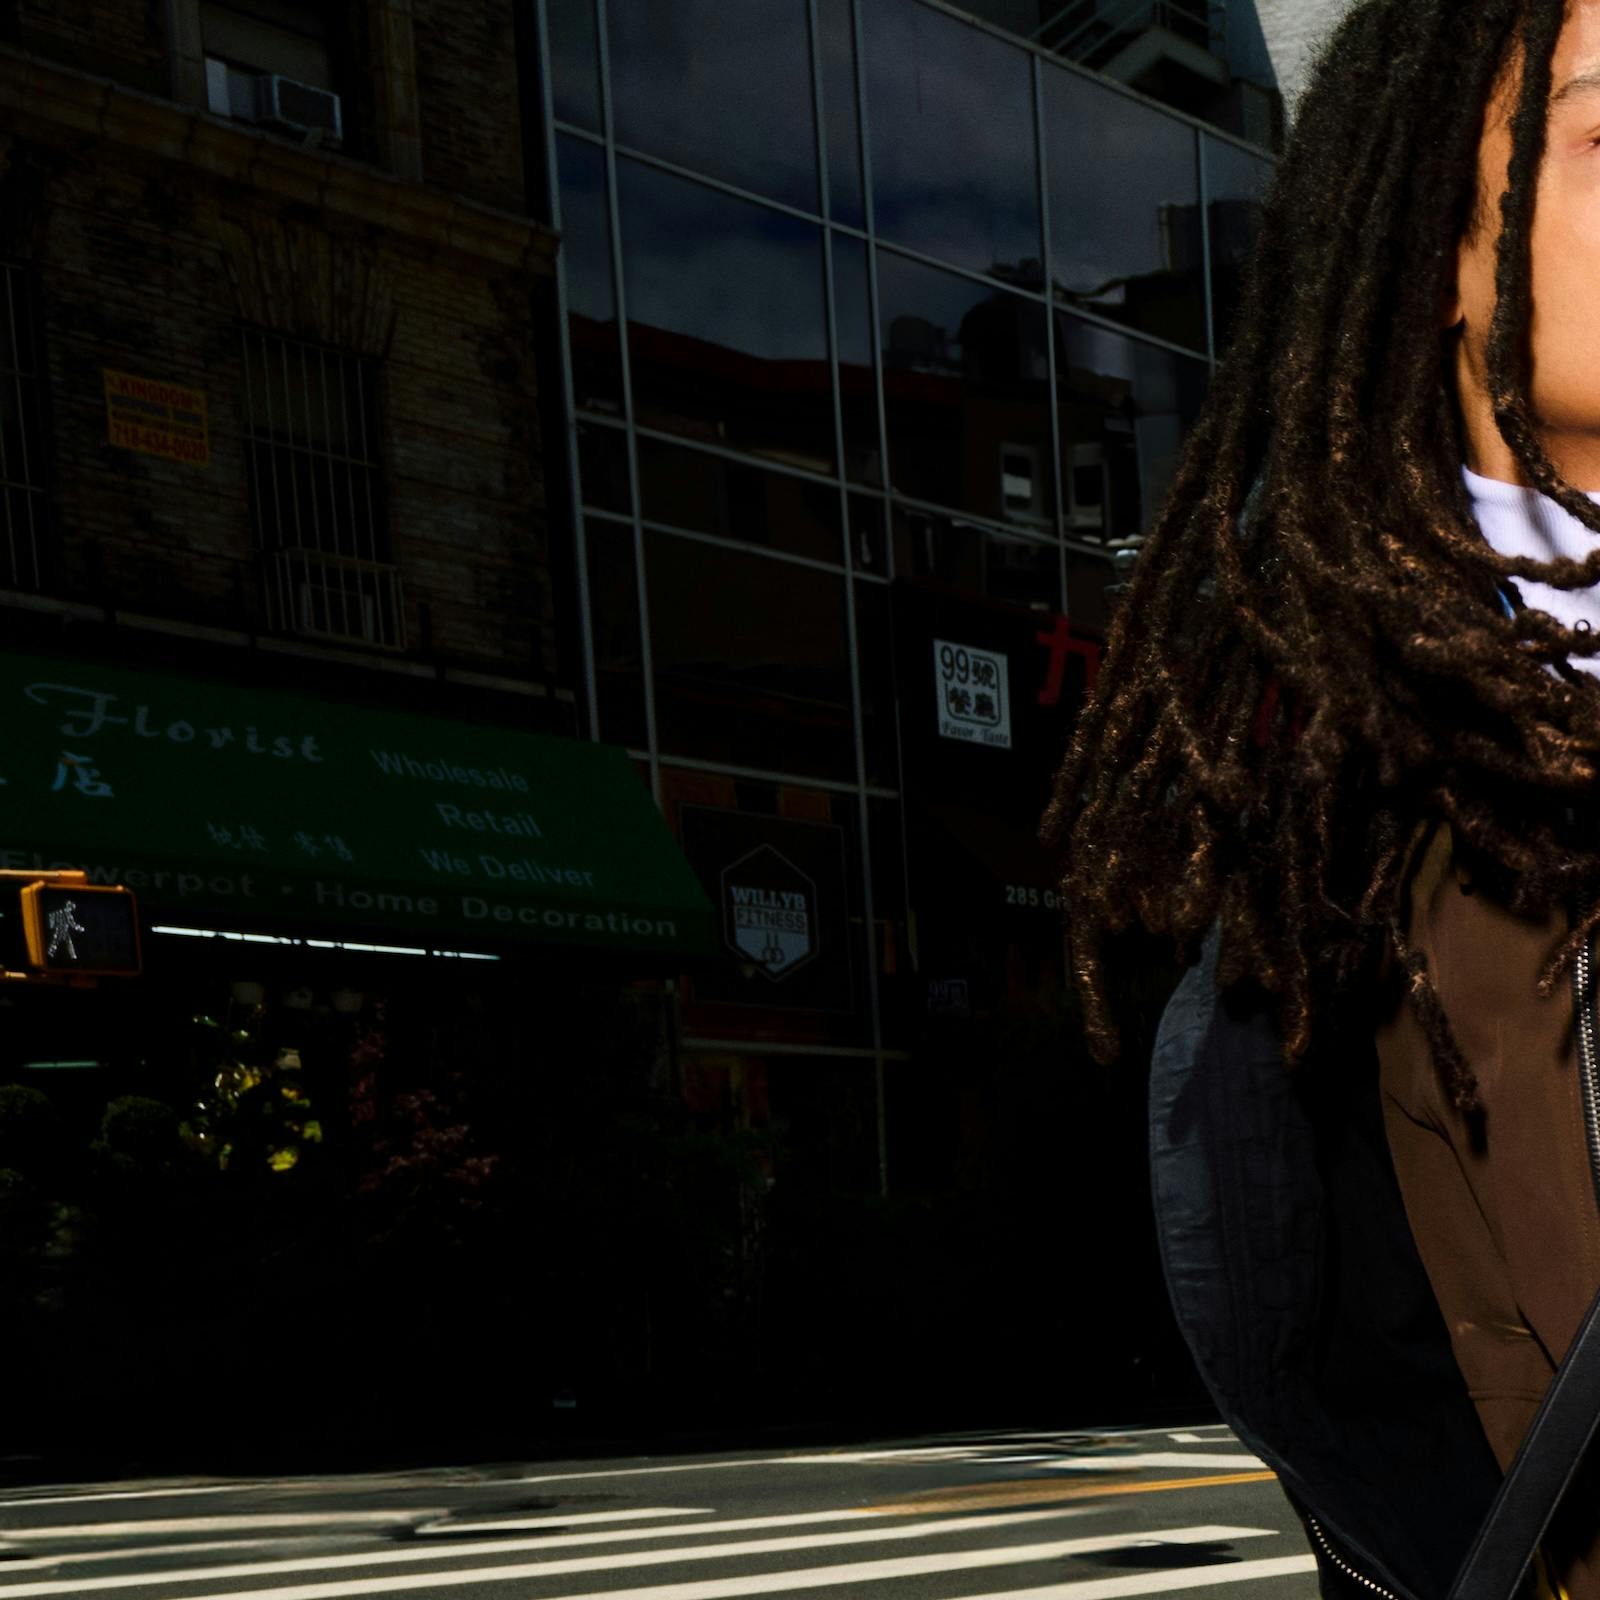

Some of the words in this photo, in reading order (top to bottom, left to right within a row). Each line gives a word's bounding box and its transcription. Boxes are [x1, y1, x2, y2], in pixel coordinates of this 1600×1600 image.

[24, 682, 325, 763] Florist
[369, 749, 530, 793] Wholesale
[435, 801, 543, 838] Retail
[418, 848, 473, 876] We
[479, 855, 596, 888] Deliver
[315, 880, 439, 916] Home
[460, 896, 678, 937] Decoration
[1005, 884, 1040, 908] 285
[736, 907, 806, 929] FITNESS
